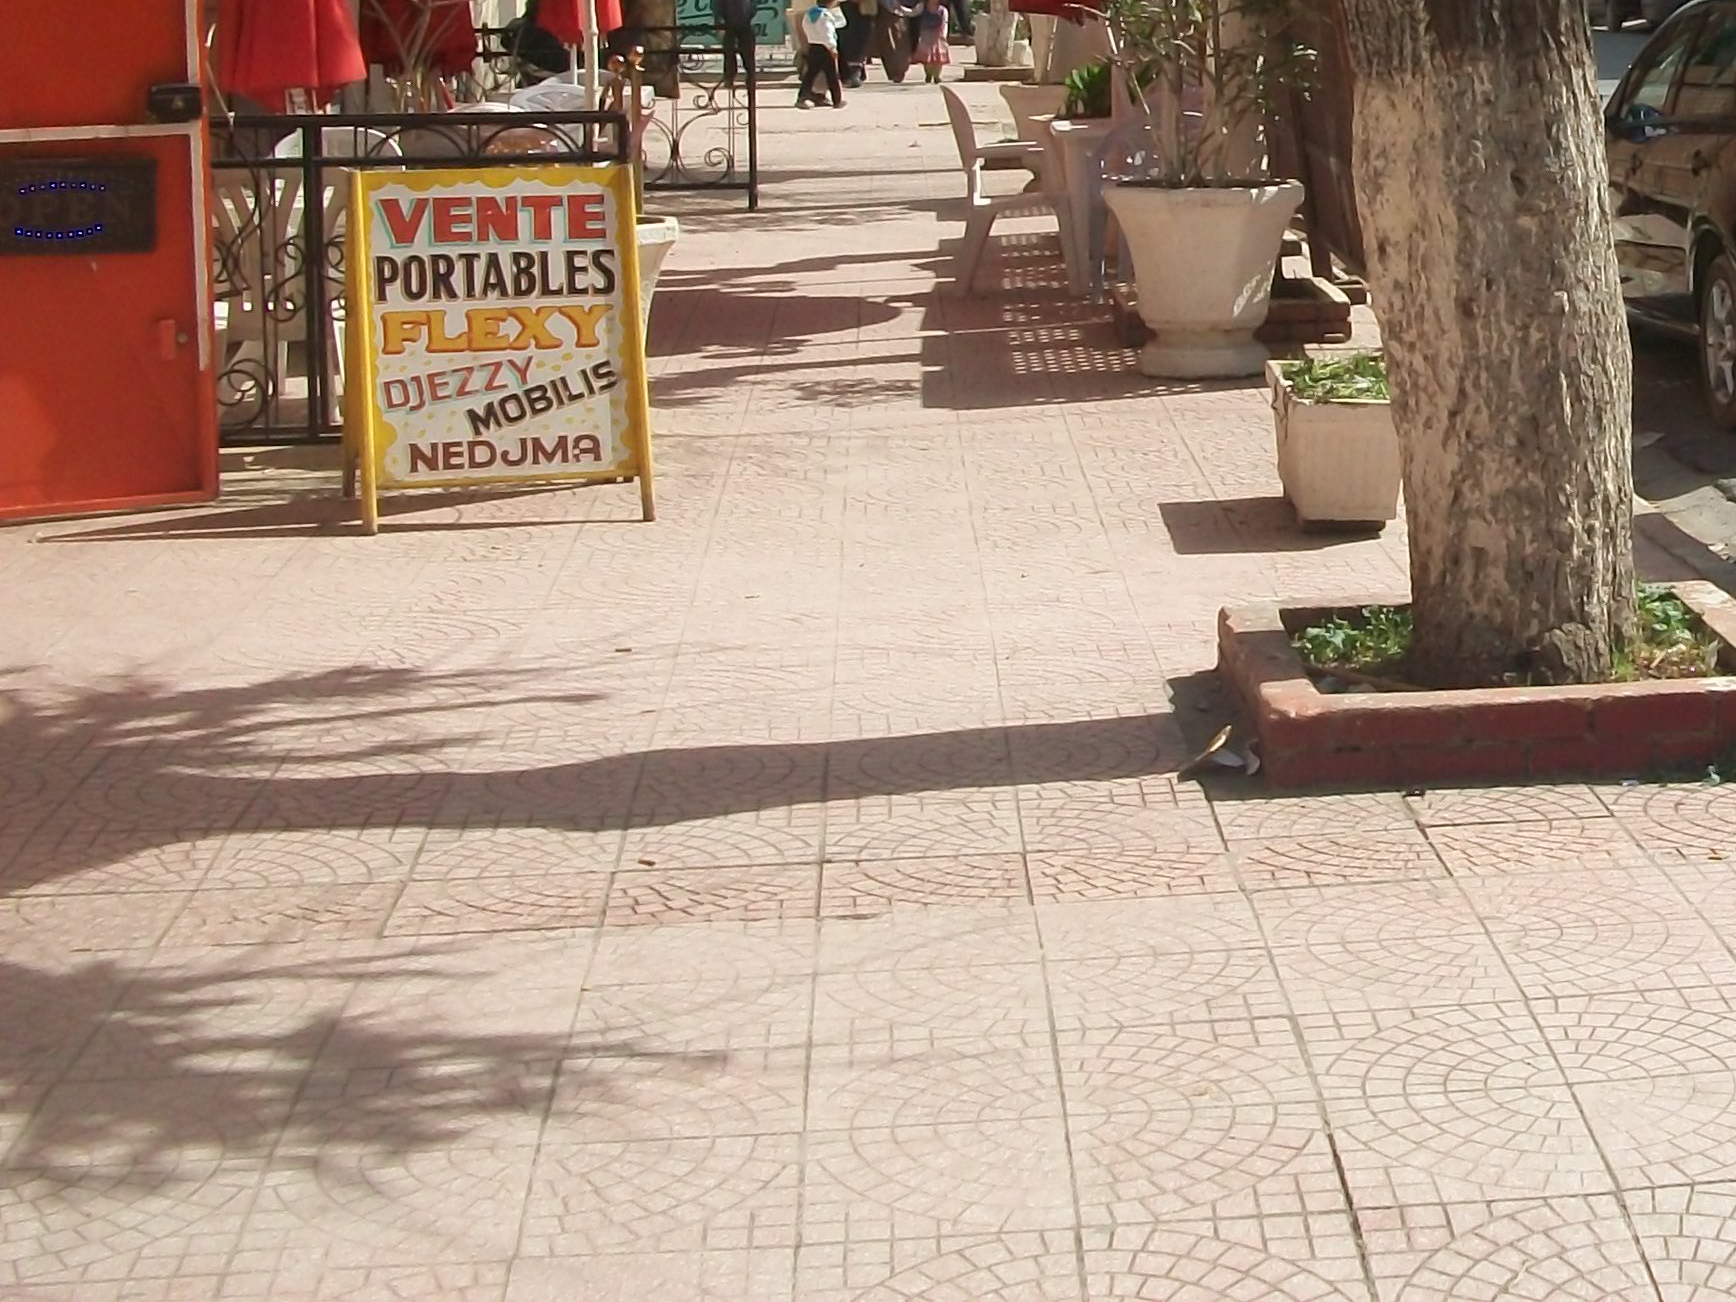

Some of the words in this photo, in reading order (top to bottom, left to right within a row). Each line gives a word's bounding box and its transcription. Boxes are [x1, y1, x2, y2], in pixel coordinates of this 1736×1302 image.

[377, 194, 607, 245] VENTE
[375, 249, 616, 301] PORTABLES
[381, 304, 614, 355] FLEXY
[383, 356, 535, 412] DJEZZY
[466, 360, 620, 437] MOBILIS
[408, 434, 603, 474] NEDJMA
